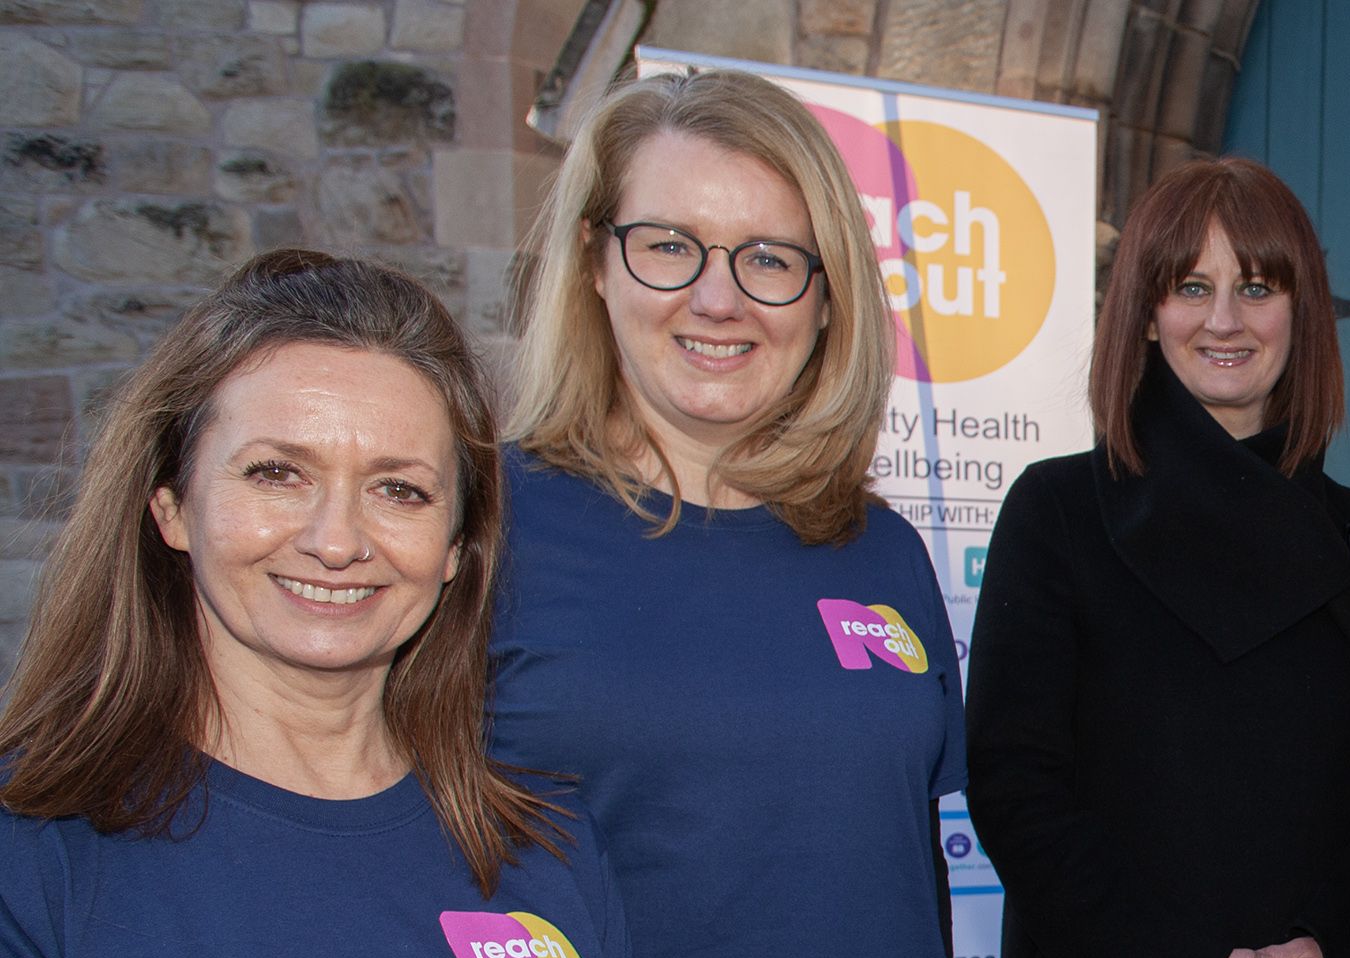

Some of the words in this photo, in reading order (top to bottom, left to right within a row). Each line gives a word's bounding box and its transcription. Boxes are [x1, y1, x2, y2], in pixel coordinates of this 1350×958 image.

[859, 190, 999, 256] ach
[879, 258, 1006, 319] out
[932, 408, 1041, 442] Health
[873, 449, 1004, 490] ellbeing
[937, 505, 995, 525] WITH:
[840, 620, 909, 638] reach
[883, 638, 919, 660] out
